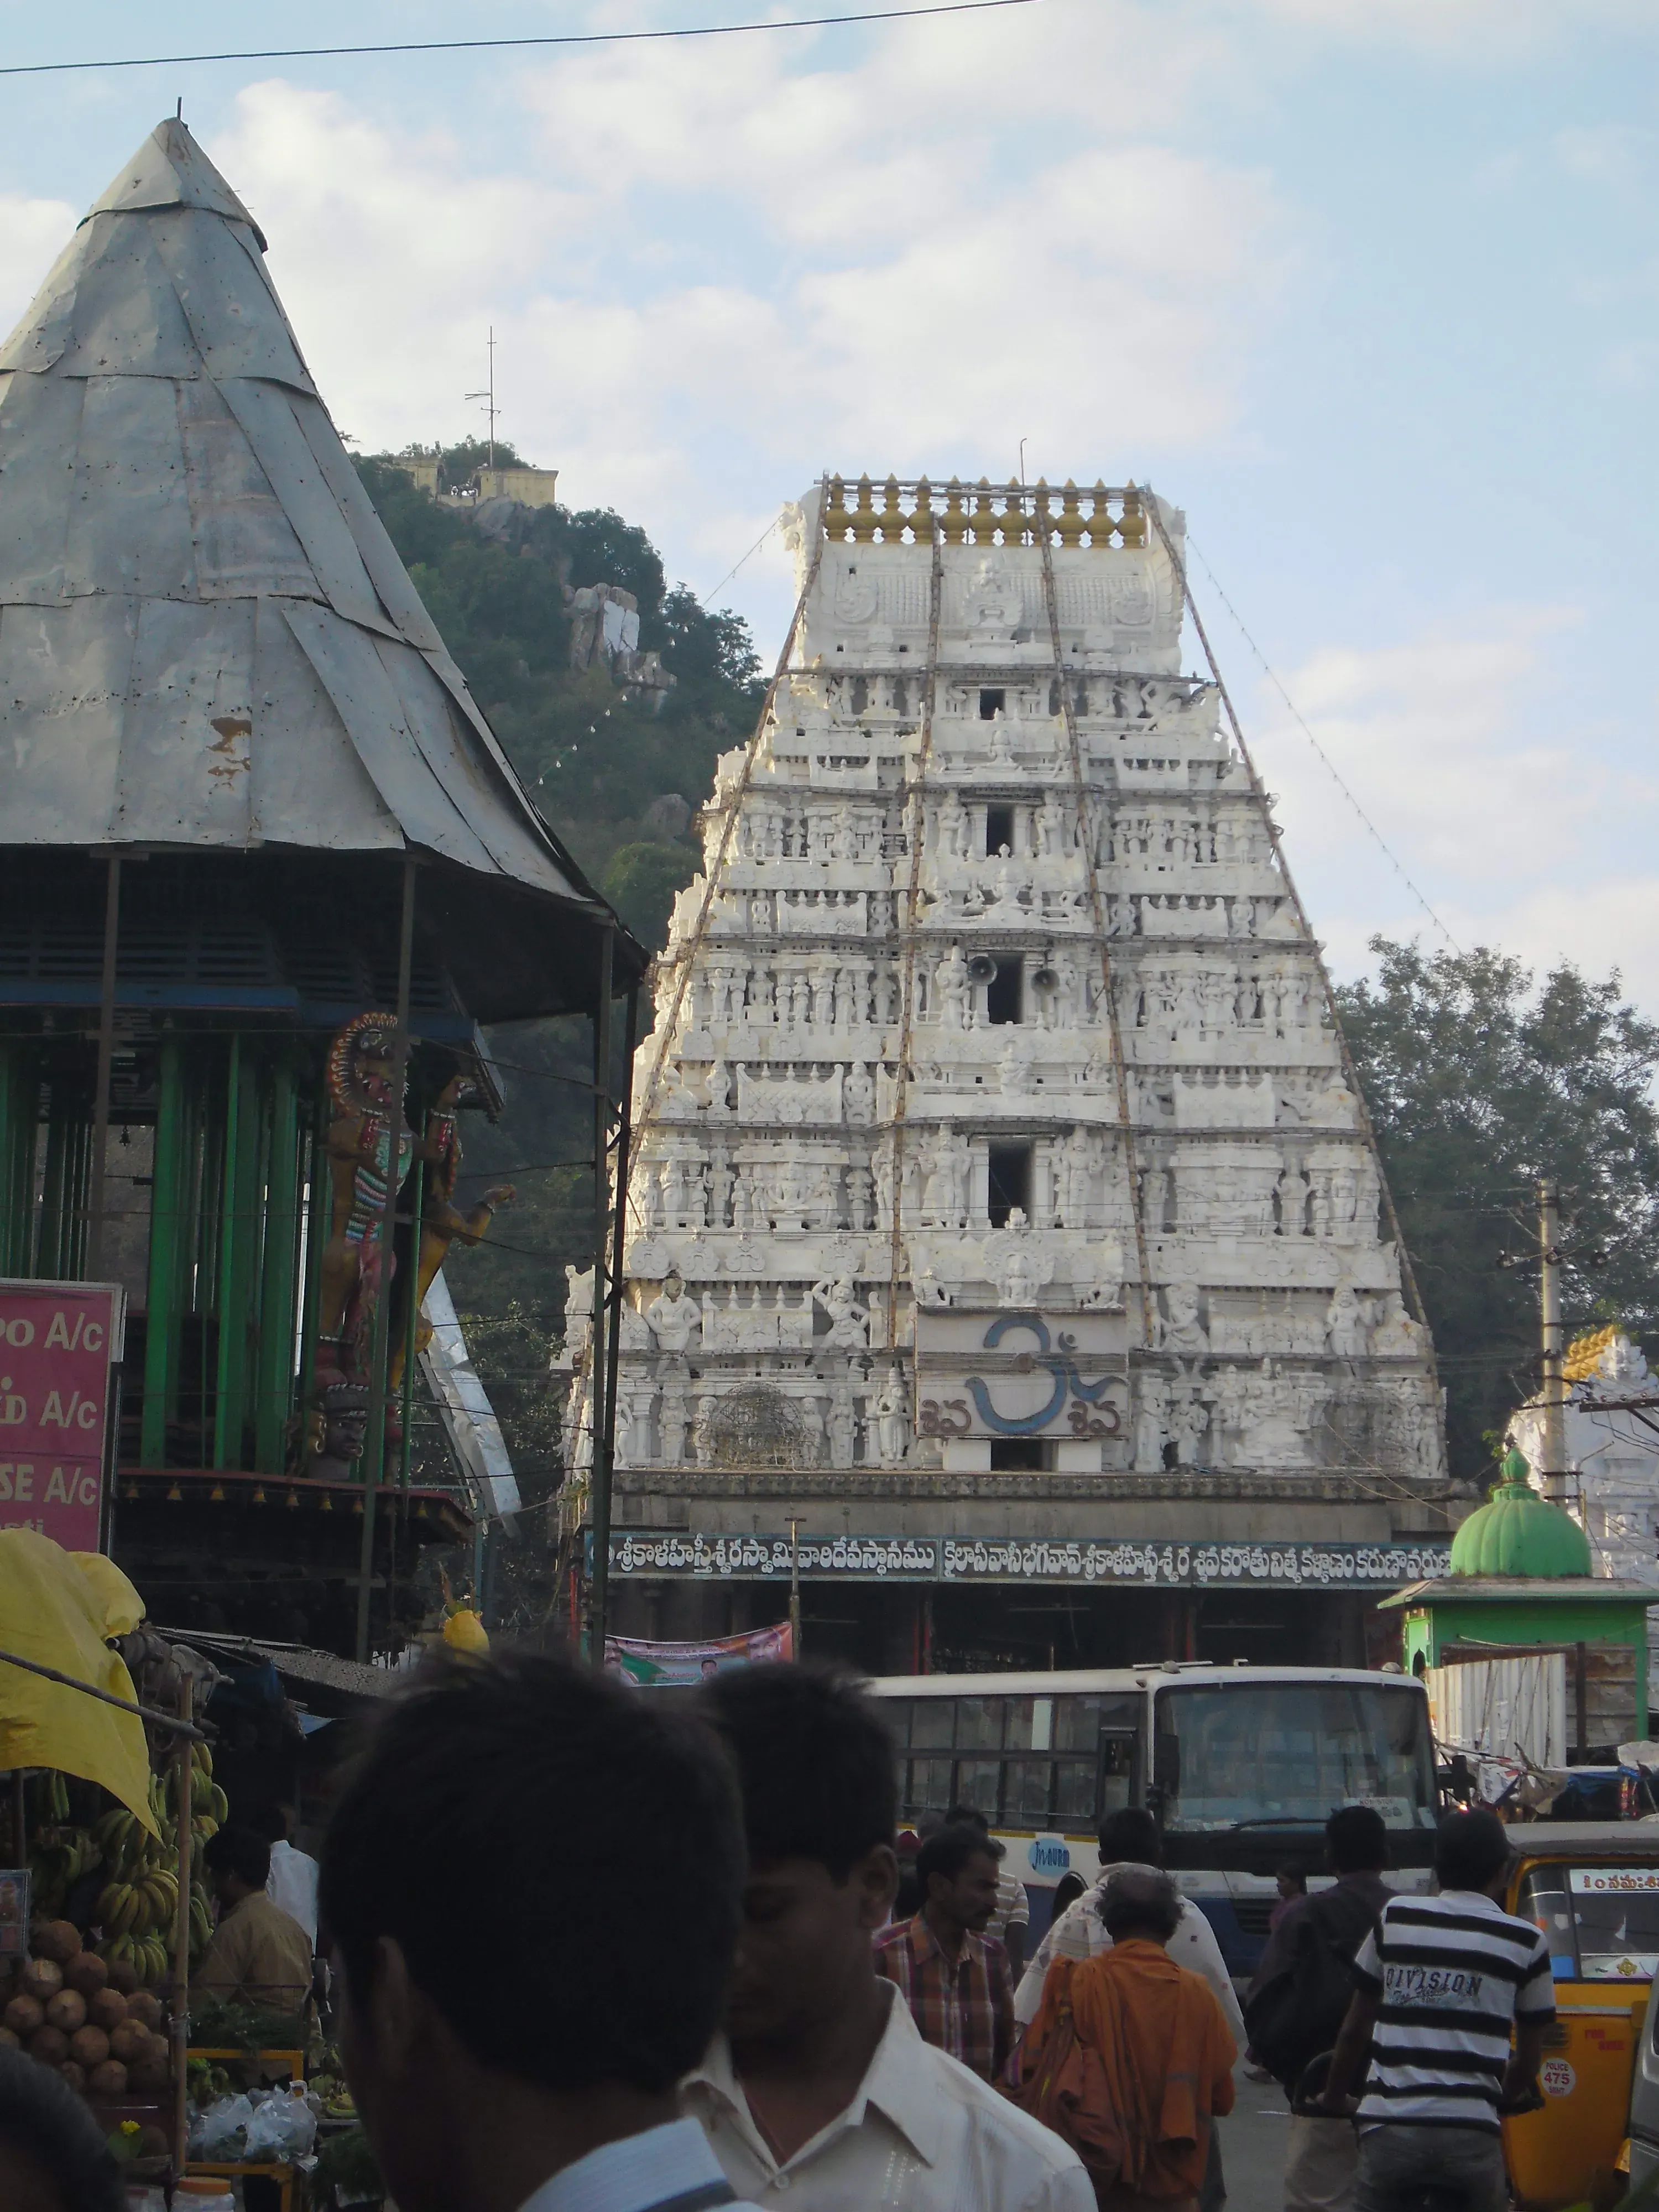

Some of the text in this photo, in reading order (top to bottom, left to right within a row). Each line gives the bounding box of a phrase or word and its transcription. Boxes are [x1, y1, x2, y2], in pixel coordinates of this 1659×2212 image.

[920, 1399, 972, 1433] శివ
[1067, 1400, 1121, 1434] శివ
[1386, 1968, 1483, 1997] DIVISION
[1544, 2072, 1570, 2085] 475
[1546, 2062, 1569, 2071] POLICE
